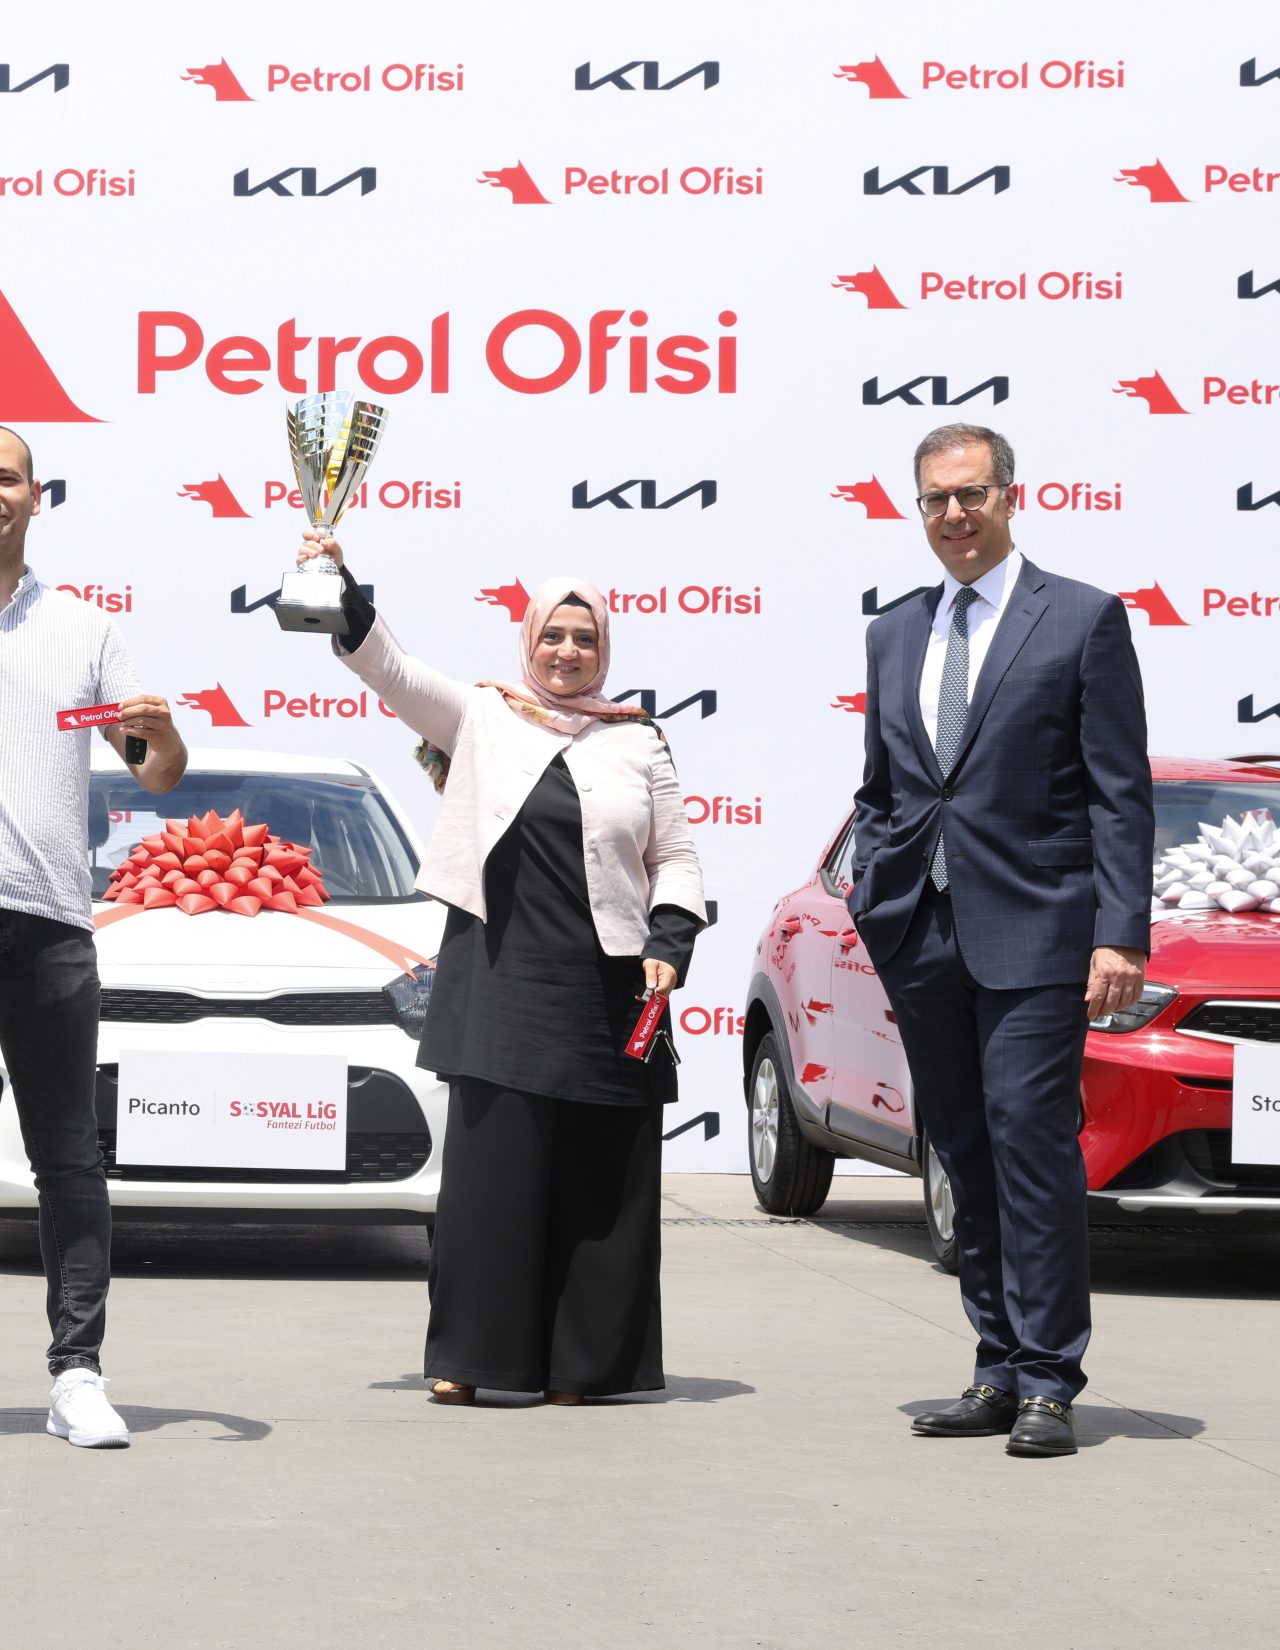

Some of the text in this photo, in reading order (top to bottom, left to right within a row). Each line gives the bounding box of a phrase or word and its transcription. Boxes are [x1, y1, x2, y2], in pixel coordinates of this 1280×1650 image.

[268, 63, 463, 93] Petrol Ofisi
[923, 60, 1125, 91] Petrol Ofisi
[53, 168, 136, 197] Ofisi
[565, 167, 763, 196] Petrol Ofisi
[1205, 165, 1280, 192] Petr
[921, 271, 1122, 301] Petrol Ofisi
[137, 309, 738, 395] Petrol Ofisi
[1203, 376, 1280, 405] Petr
[378, 480, 461, 510] Ofisi
[1037, 482, 1122, 511] Ofisi
[600, 585, 761, 615] trol Ofisi
[1203, 588, 1280, 616] Petr
[80, 713, 103, 722] Petrol
[264, 690, 367, 718] Petrol
[683, 796, 762, 825] Ofisi
[128, 1098, 201, 1116] Picanto
[266, 1119, 337, 1131] Fantezi Futbol
